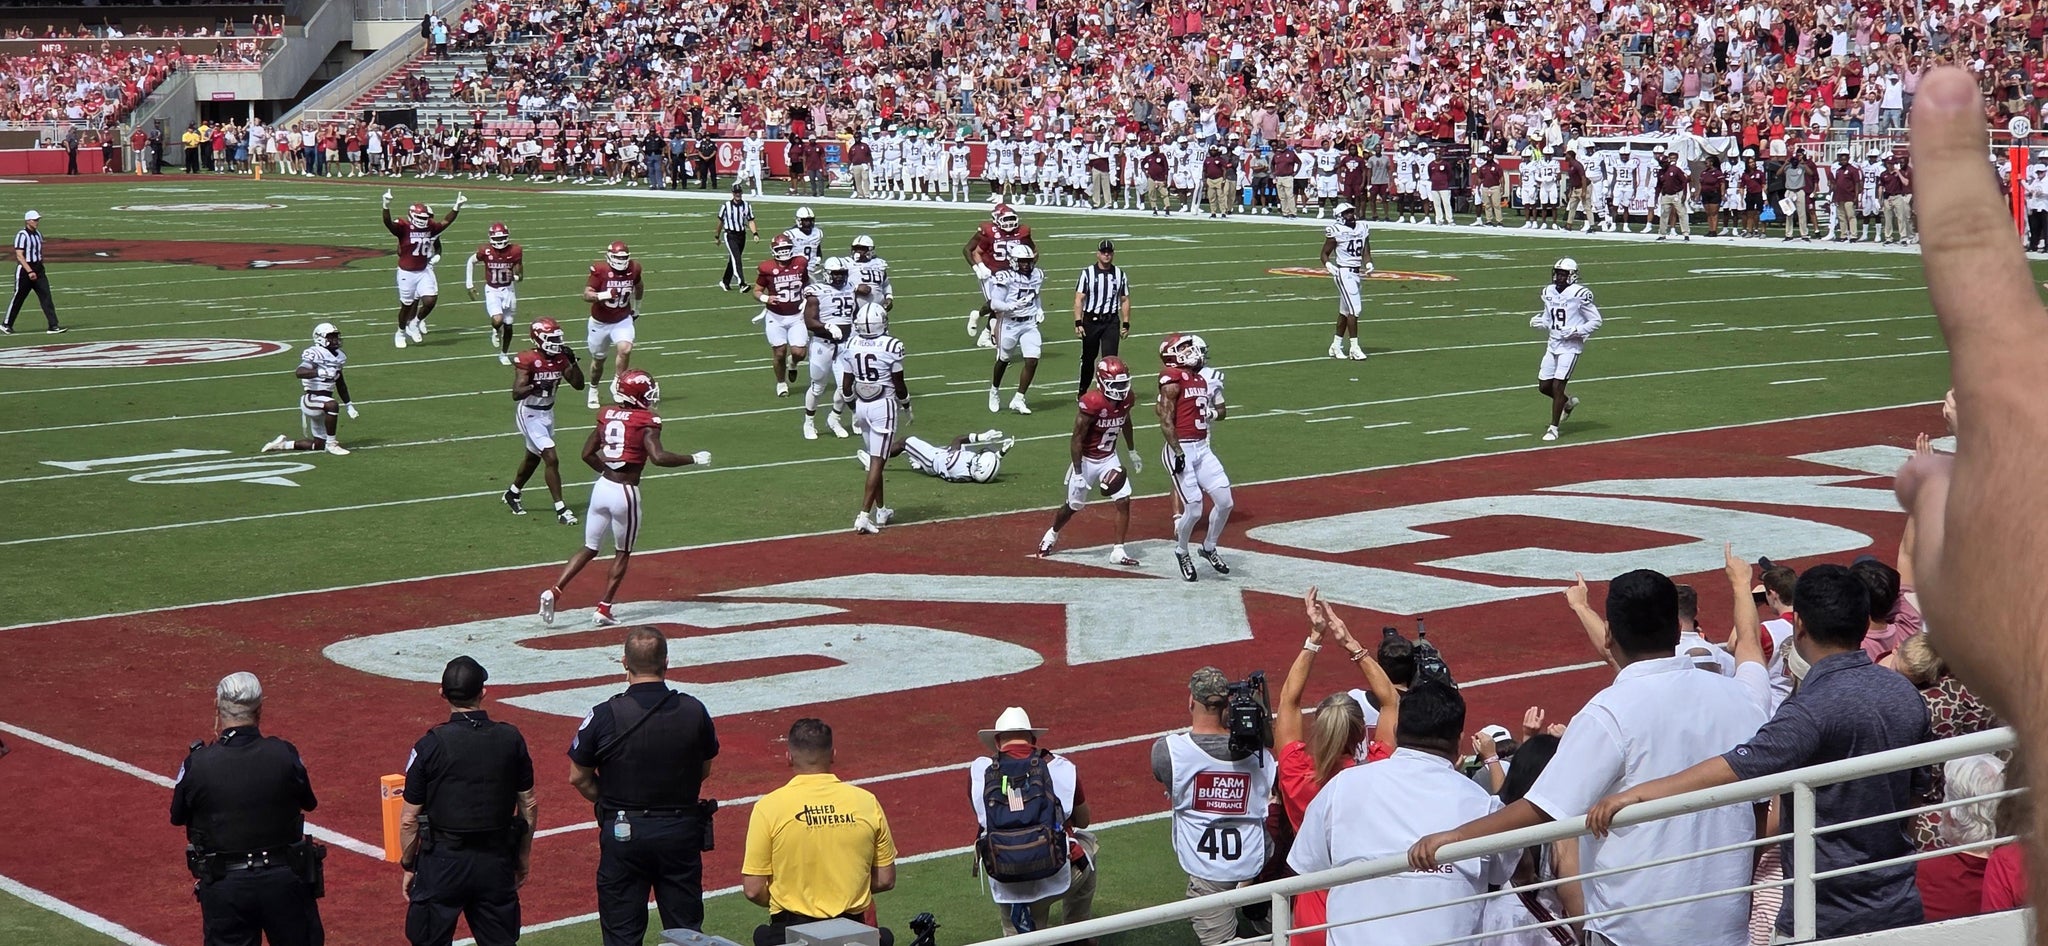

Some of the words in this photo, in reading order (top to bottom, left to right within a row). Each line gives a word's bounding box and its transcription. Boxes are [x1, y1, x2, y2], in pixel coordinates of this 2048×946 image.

[41, 44, 62, 52] NF8
[1196, 151, 1205, 161] 10
[1320, 156, 1330, 165] 61
[1620, 169, 1629, 178] 21
[1347, 239, 1363, 257] 42
[490, 269, 512, 284] 10
[861, 269, 882, 283] 90
[775, 281, 803, 303] 52
[832, 297, 853, 317] 35
[1551, 308, 1566, 330] 19
[855, 353, 879, 381] 16
[534, 372, 562, 381] ARKANS
[605, 409, 633, 420] BLAKE
[1194, 397, 1208, 430] 3
[603, 420, 625, 458] 9
[1097, 427, 1121, 452] 6
[1213, 777, 1244, 788] FARM
[1198, 788, 1244, 799] BUREAU
[804, 805, 835, 815] ALLIED
[1206, 801, 1242, 809] INSURANCE
[806, 813, 856, 826] UNIVERSAL
[1197, 828, 1242, 860] 40
